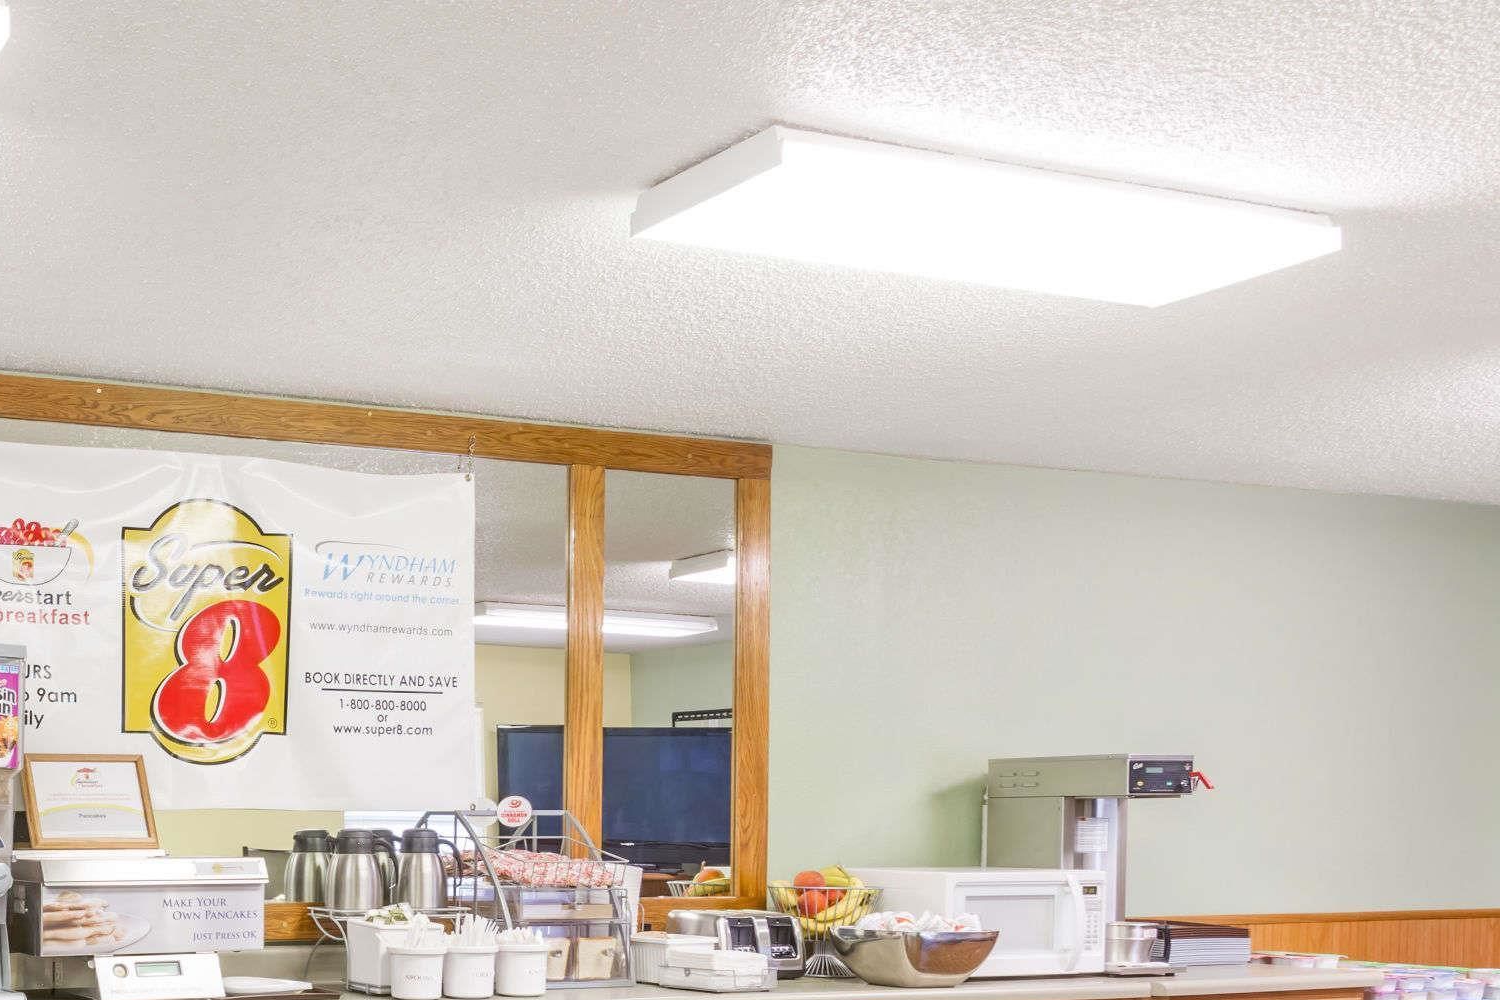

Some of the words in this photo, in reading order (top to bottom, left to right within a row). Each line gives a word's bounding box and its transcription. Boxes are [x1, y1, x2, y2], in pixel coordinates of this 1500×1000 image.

[322, 552, 457, 582] WYNDHAM
[131, 533, 285, 624] Super
[366, 572, 453, 588] REWARDS
[304, 588, 350, 600] Rewards
[350, 591, 372, 603] right
[375, 592, 410, 604] around
[308, 620, 454, 638] www.wyndhamrewards.com
[150, 599, 281, 748] 8
[304, 671, 341, 685] BOOK
[344, 673, 396, 687] DIRECTLY
[399, 675, 425, 688] AND
[428, 676, 458, 689] SAVE
[36, 687, 77, 703] 9am
[338, 698, 427, 712] 1-800-800-8000
[23, 709, 45, 730] ily
[376, 714, 389, 723] or
[332, 724, 433, 738] www.super8.com
[161, 898, 195, 909] MAKE
[196, 896, 228, 908] YOUR
[172, 910, 201, 921] OWN
[205, 909, 259, 921] PANCAKES
[192, 930, 213, 943] JUST
[215, 930, 240, 941] PRESS
